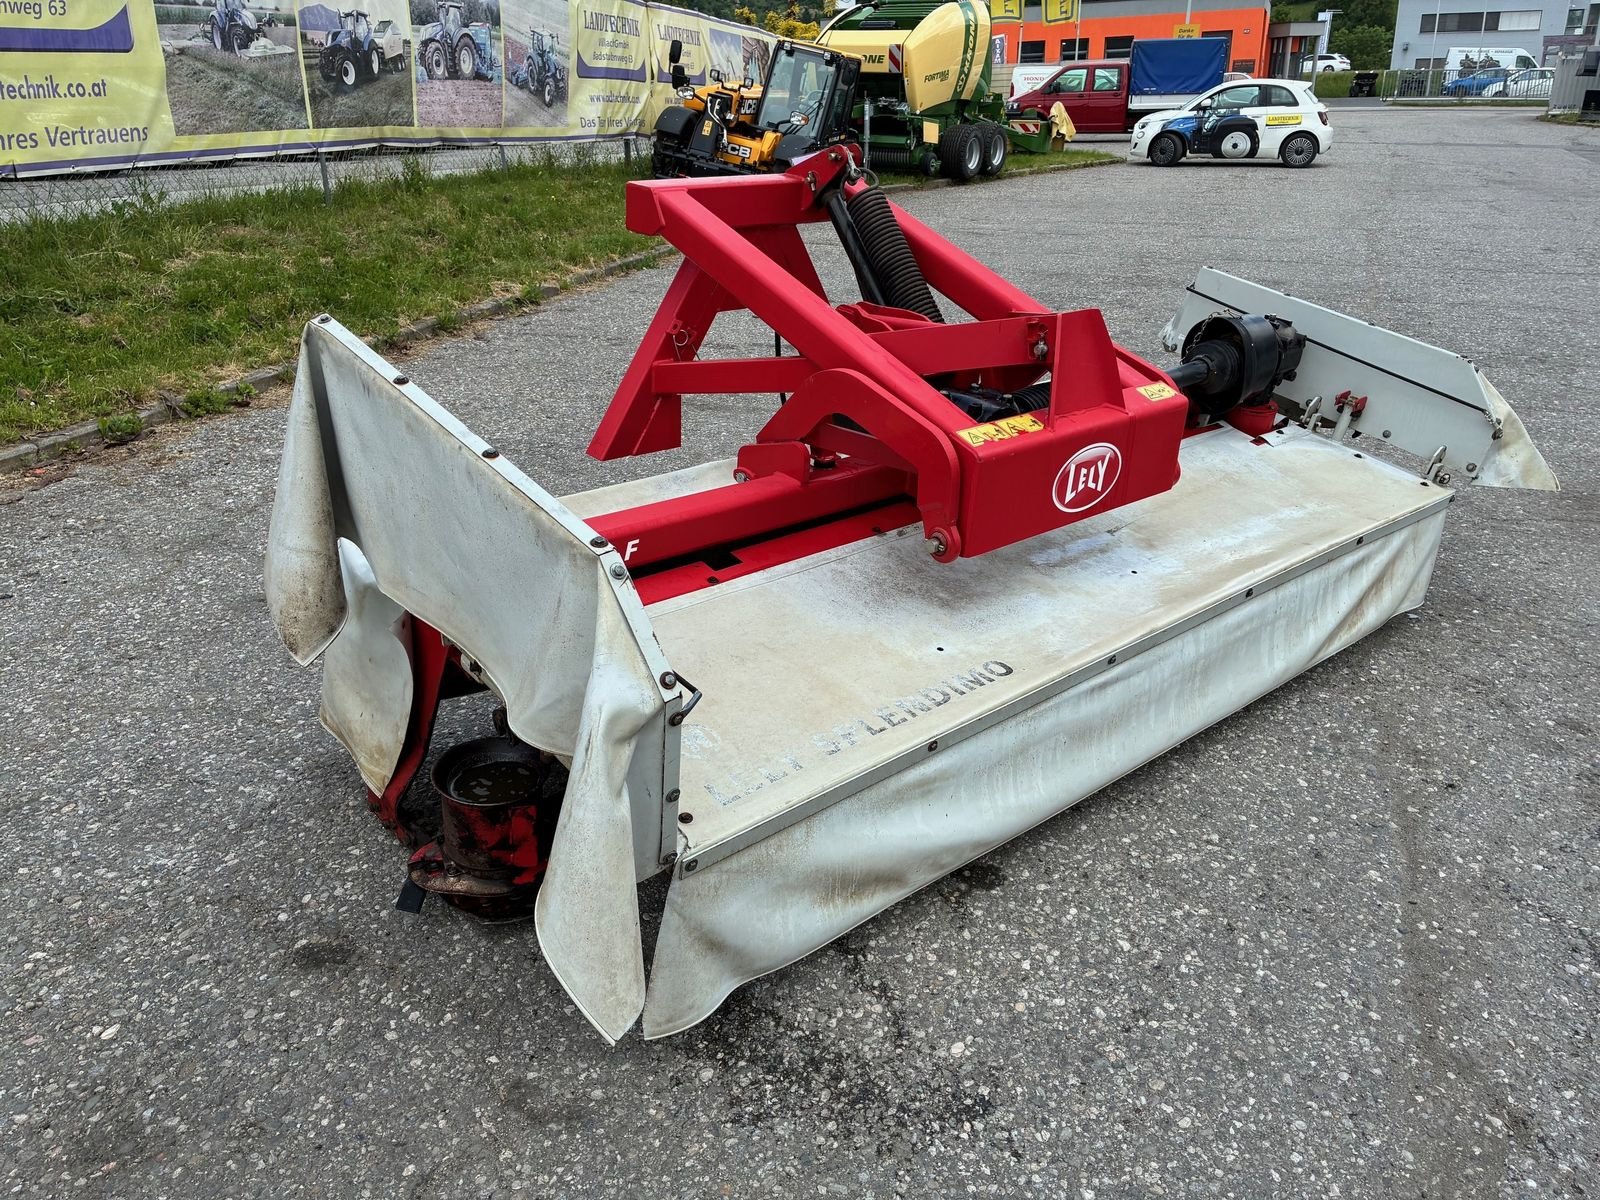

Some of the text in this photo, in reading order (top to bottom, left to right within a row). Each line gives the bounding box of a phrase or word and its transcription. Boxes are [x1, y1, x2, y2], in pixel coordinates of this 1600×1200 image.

[48, 0, 67, 16] 63
[583, 10, 640, 37] LANDTECHNIK
[740, 99, 758, 114] JCB
[580, 117, 596, 128] Das
[45, 126, 149, 147] Vertrauens
[727, 143, 751, 158] CB
[1064, 451, 1111, 505] LELY
[811, 659, 1015, 756] SPLENDIMO
